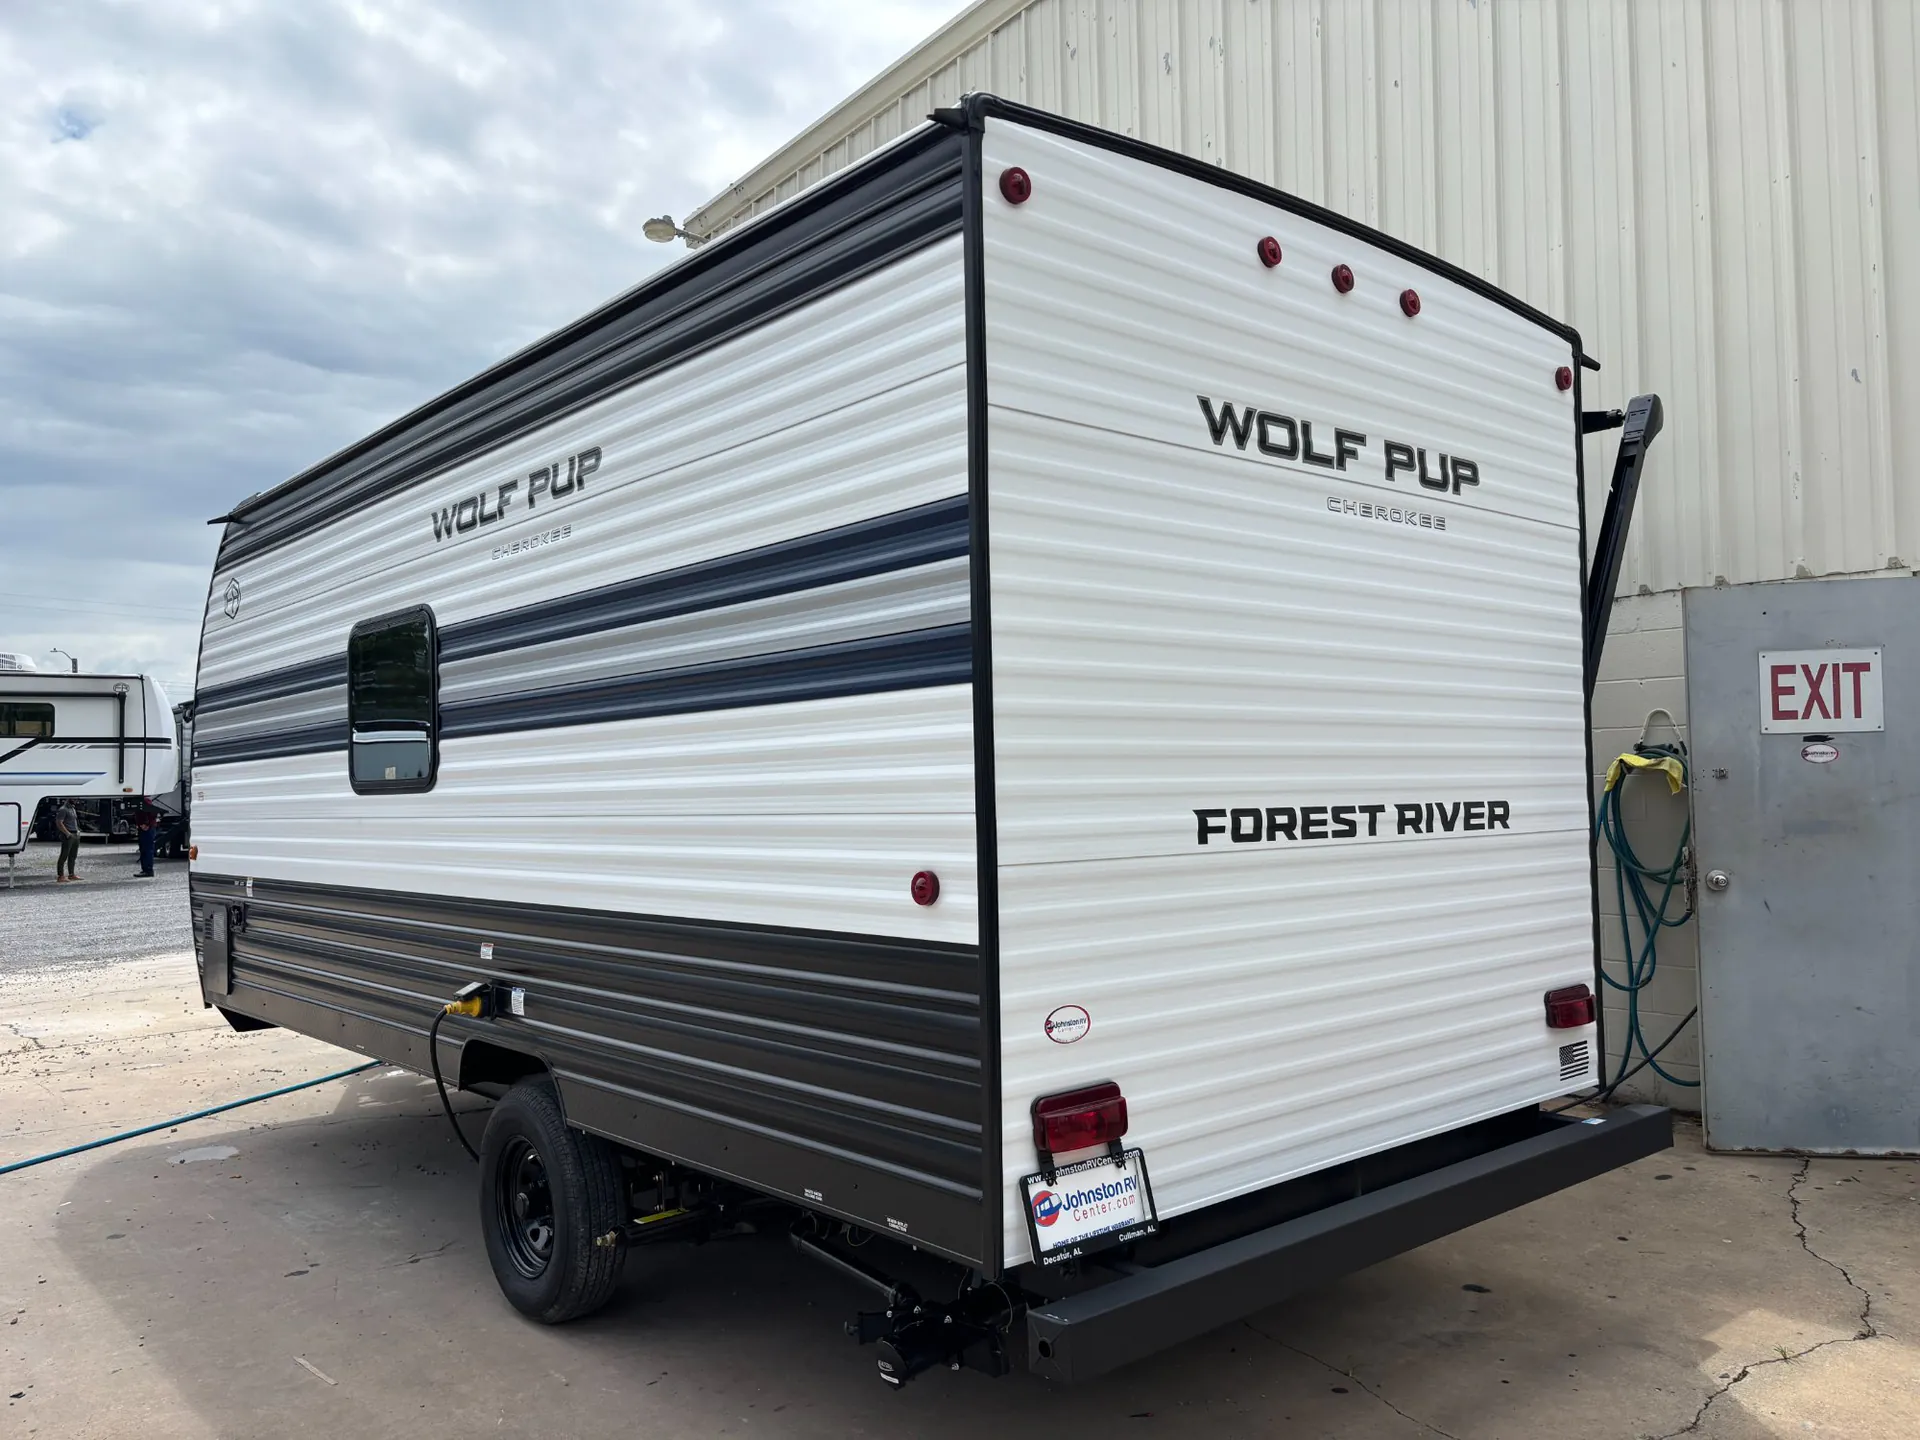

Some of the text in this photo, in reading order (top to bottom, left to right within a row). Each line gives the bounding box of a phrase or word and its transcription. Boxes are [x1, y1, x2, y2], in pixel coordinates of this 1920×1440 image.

[1196, 394, 1480, 495] WOLF PUP
[431, 446, 602, 542] WOLF PUP
[1326, 496, 1447, 531] CHEROKEE
[491, 523, 572, 561] CHEROKEE
[1770, 662, 1871, 720] EXIT
[1192, 800, 1511, 845] FOREST RIVER
[1062, 1175, 1138, 1211] Johnston RV
[1073, 1194, 1136, 1222] Center.com
[1052, 1238, 1069, 1249] HOME
[1118, 1225, 1156, 1242] Cullman, AL
[1043, 1248, 1083, 1265] Decatur, AL
